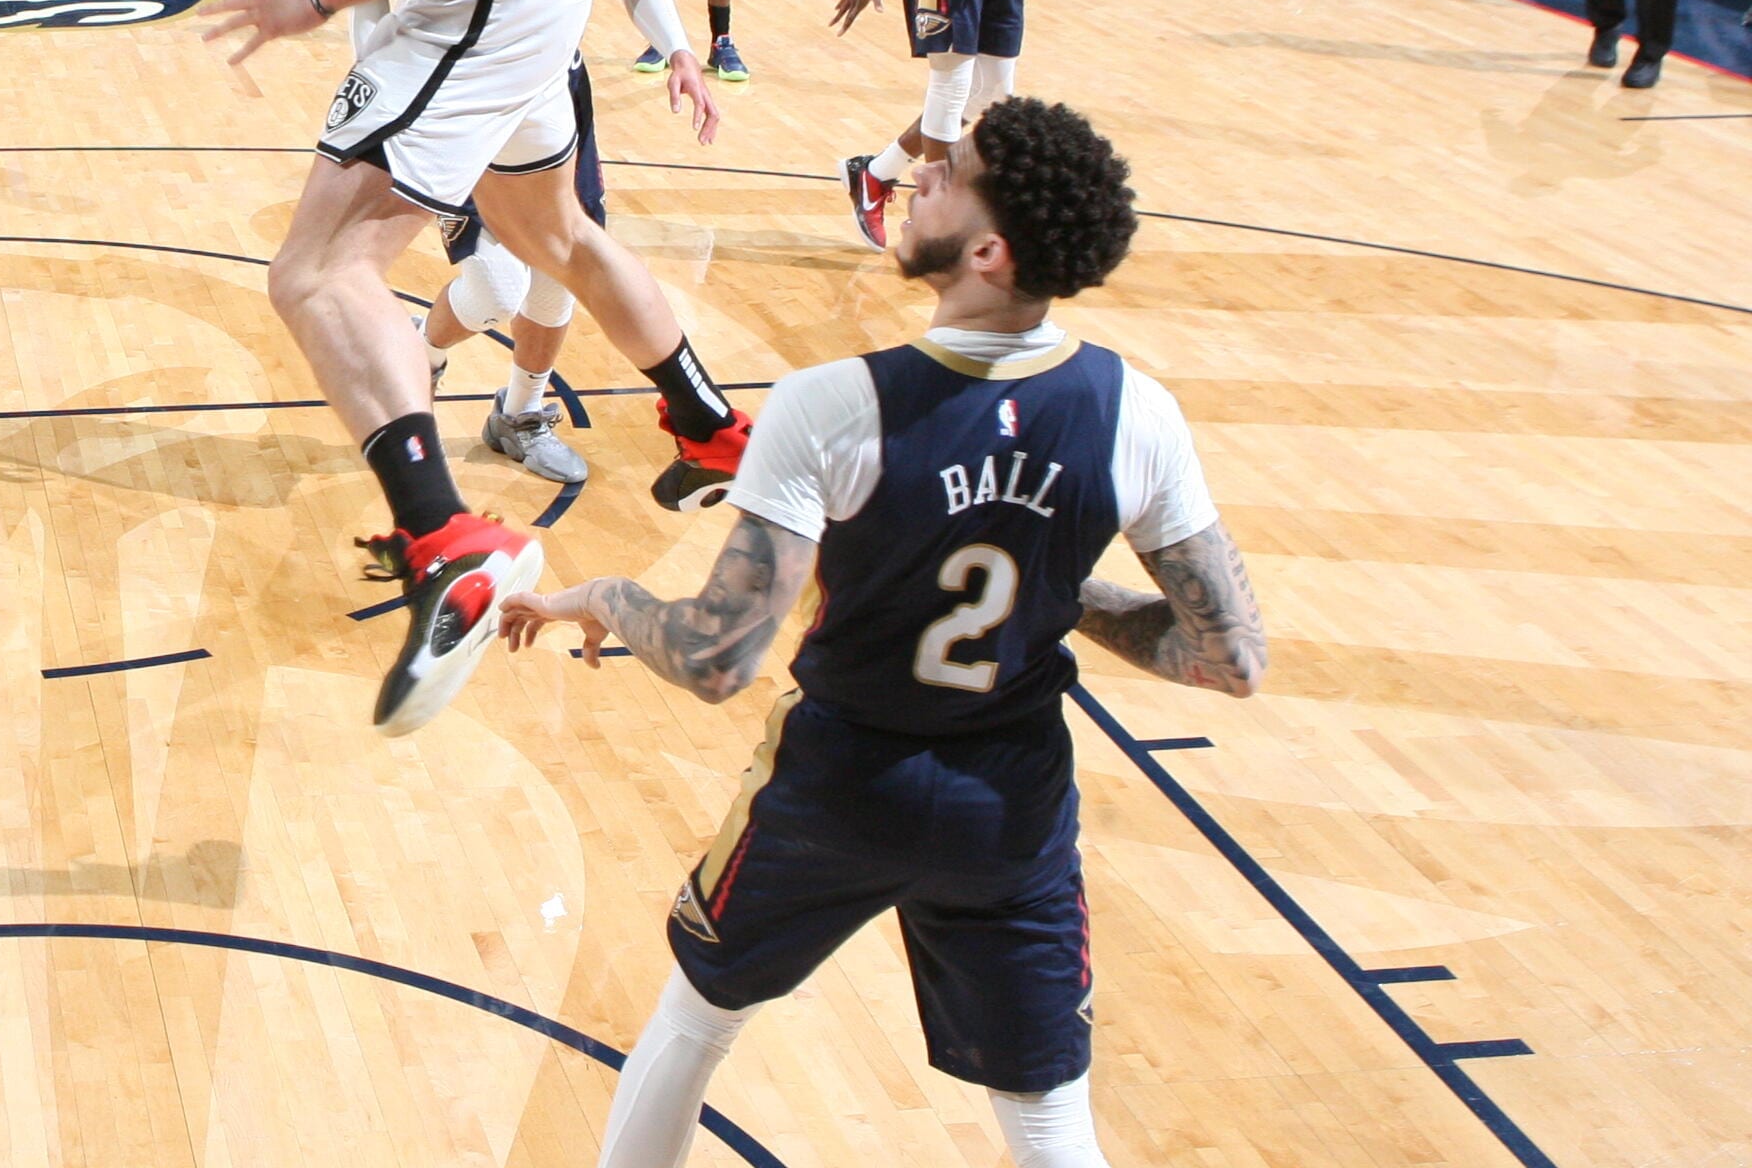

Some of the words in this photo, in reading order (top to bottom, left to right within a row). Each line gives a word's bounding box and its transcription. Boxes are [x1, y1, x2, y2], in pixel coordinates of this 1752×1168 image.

[338, 76, 371, 108] ETS
[939, 450, 1064, 519] BALL
[912, 542, 1021, 694] 2
